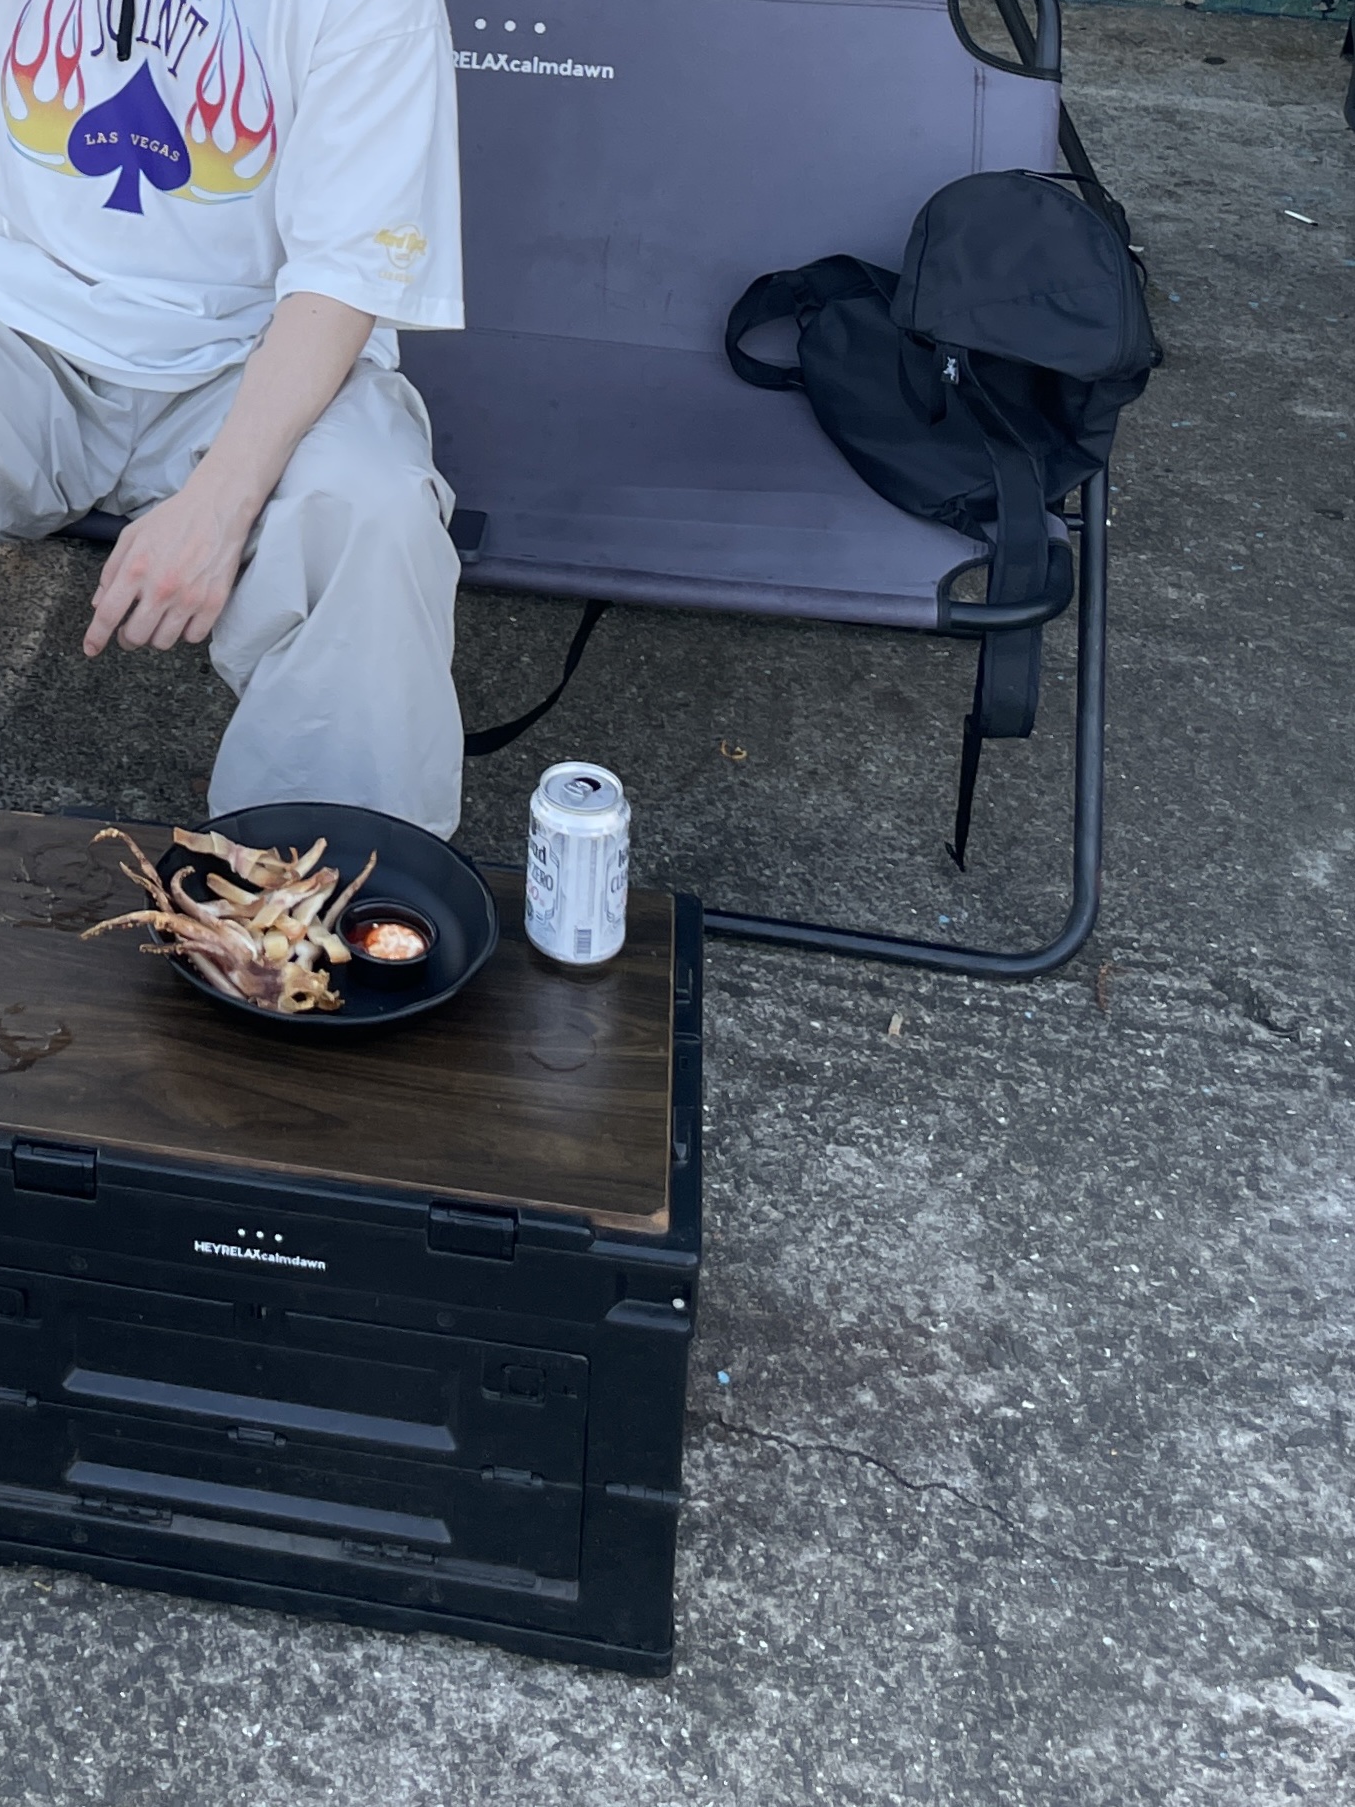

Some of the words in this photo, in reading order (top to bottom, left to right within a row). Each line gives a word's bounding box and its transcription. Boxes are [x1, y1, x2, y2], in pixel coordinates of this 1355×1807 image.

[84, 131, 119, 146] LAS
[130, 133, 181, 162] VEGAS
[193, 1239, 327, 1272] HEYRELAXcalmdawn
